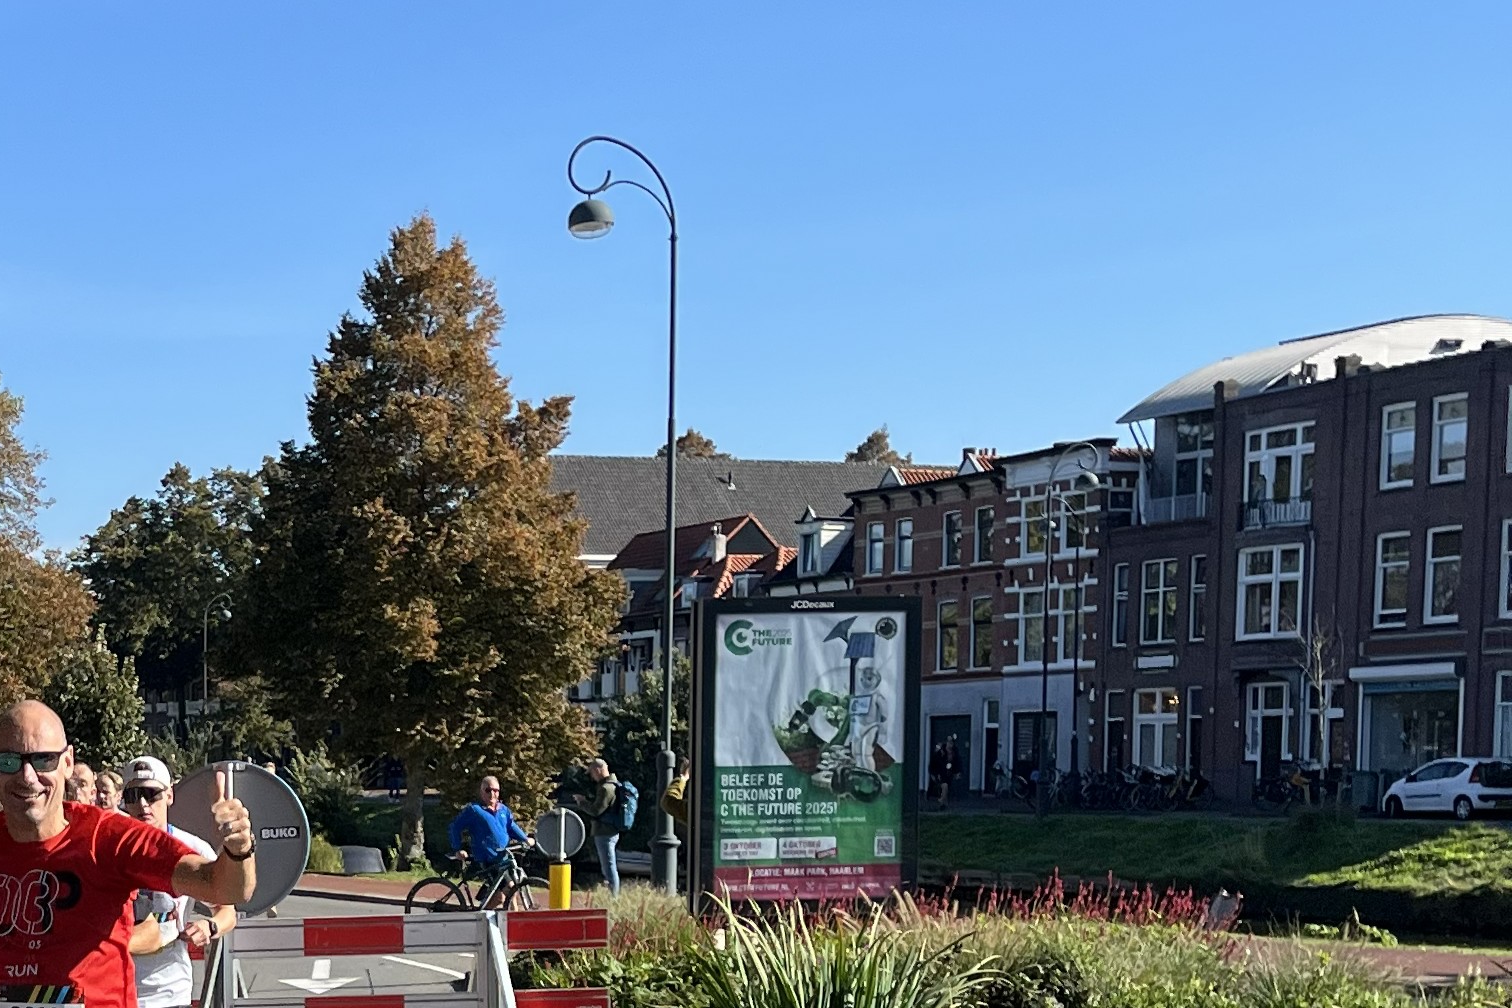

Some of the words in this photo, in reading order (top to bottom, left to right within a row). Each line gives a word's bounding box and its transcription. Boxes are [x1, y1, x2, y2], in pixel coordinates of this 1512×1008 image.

[791, 600, 834, 609] JCDecaux
[752, 629, 772, 637] THE
[752, 638, 793, 646] FUTURE
[721, 774, 765, 787] BELEEF
[768, 773, 783, 785] DE
[721, 788, 784, 801] TOEKOMST
[786, 787, 802, 800] OP
[720, 804, 729, 816] C
[732, 803, 755, 816] THE
[758, 802, 802, 815] FUTURE
[805, 802, 837, 815] 2025!
[261, 827, 298, 839] BUKO
